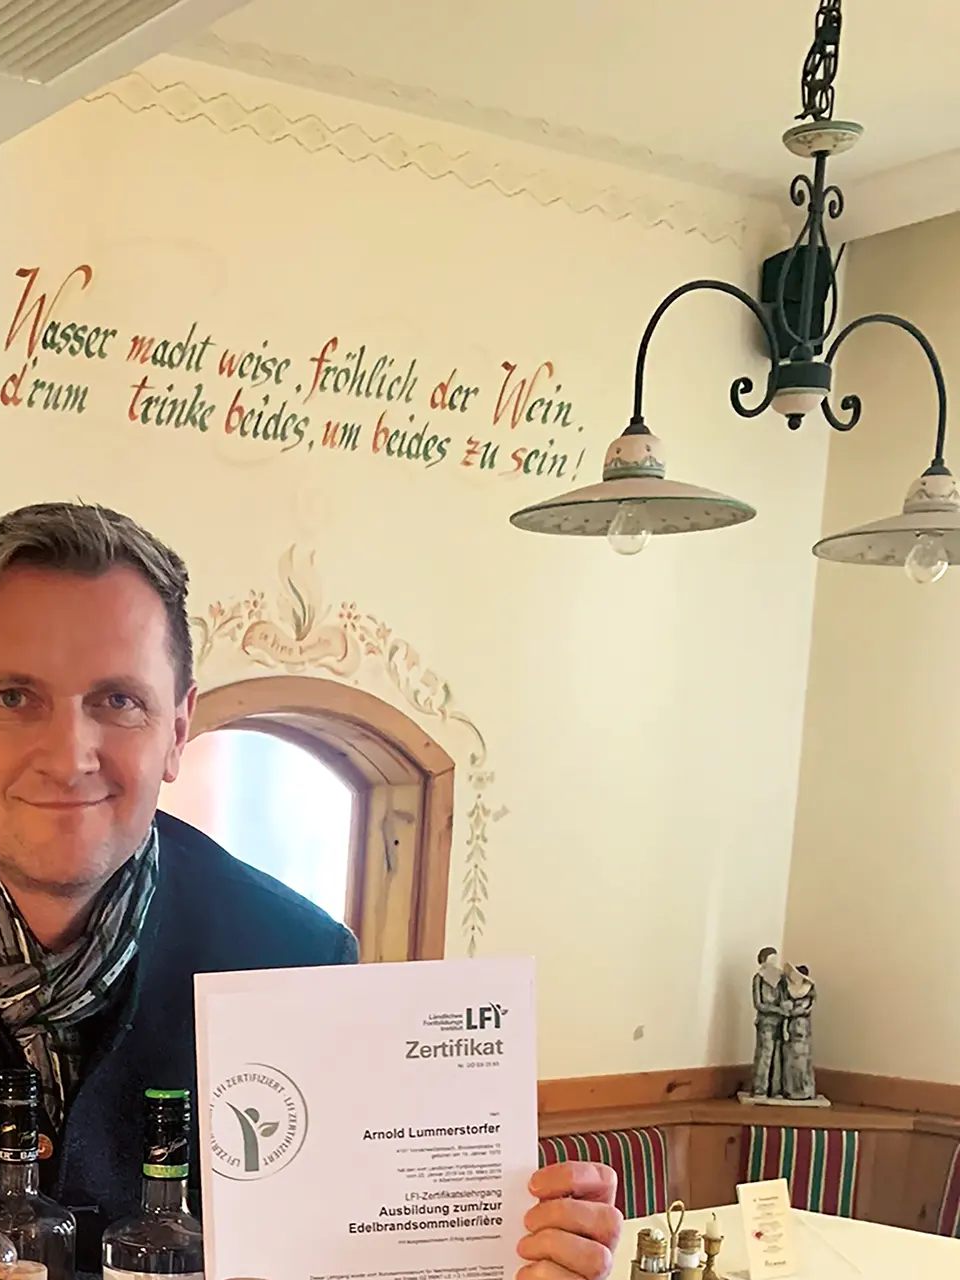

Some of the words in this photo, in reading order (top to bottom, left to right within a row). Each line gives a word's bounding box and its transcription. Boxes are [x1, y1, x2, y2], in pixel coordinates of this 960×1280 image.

[3, 264, 118, 360] Wasser
[126, 321, 217, 373] macht
[302, 336, 418, 405] fröhlich
[429, 367, 479, 413] der
[128, 375, 217, 433] trinke
[321, 420, 362, 452] um
[371, 409, 452, 469] beides
[460, 434, 500, 470] zu
[497, 438, 587, 482] sein!
[405, 1037, 504, 1059] Zertifikat
[362, 1128, 405, 1141] Arnold
[408, 1123, 501, 1139] Lummerstorfer
[378, 1203, 450, 1217] Ausbildung
[453, 1201, 503, 1213] zum/zur
